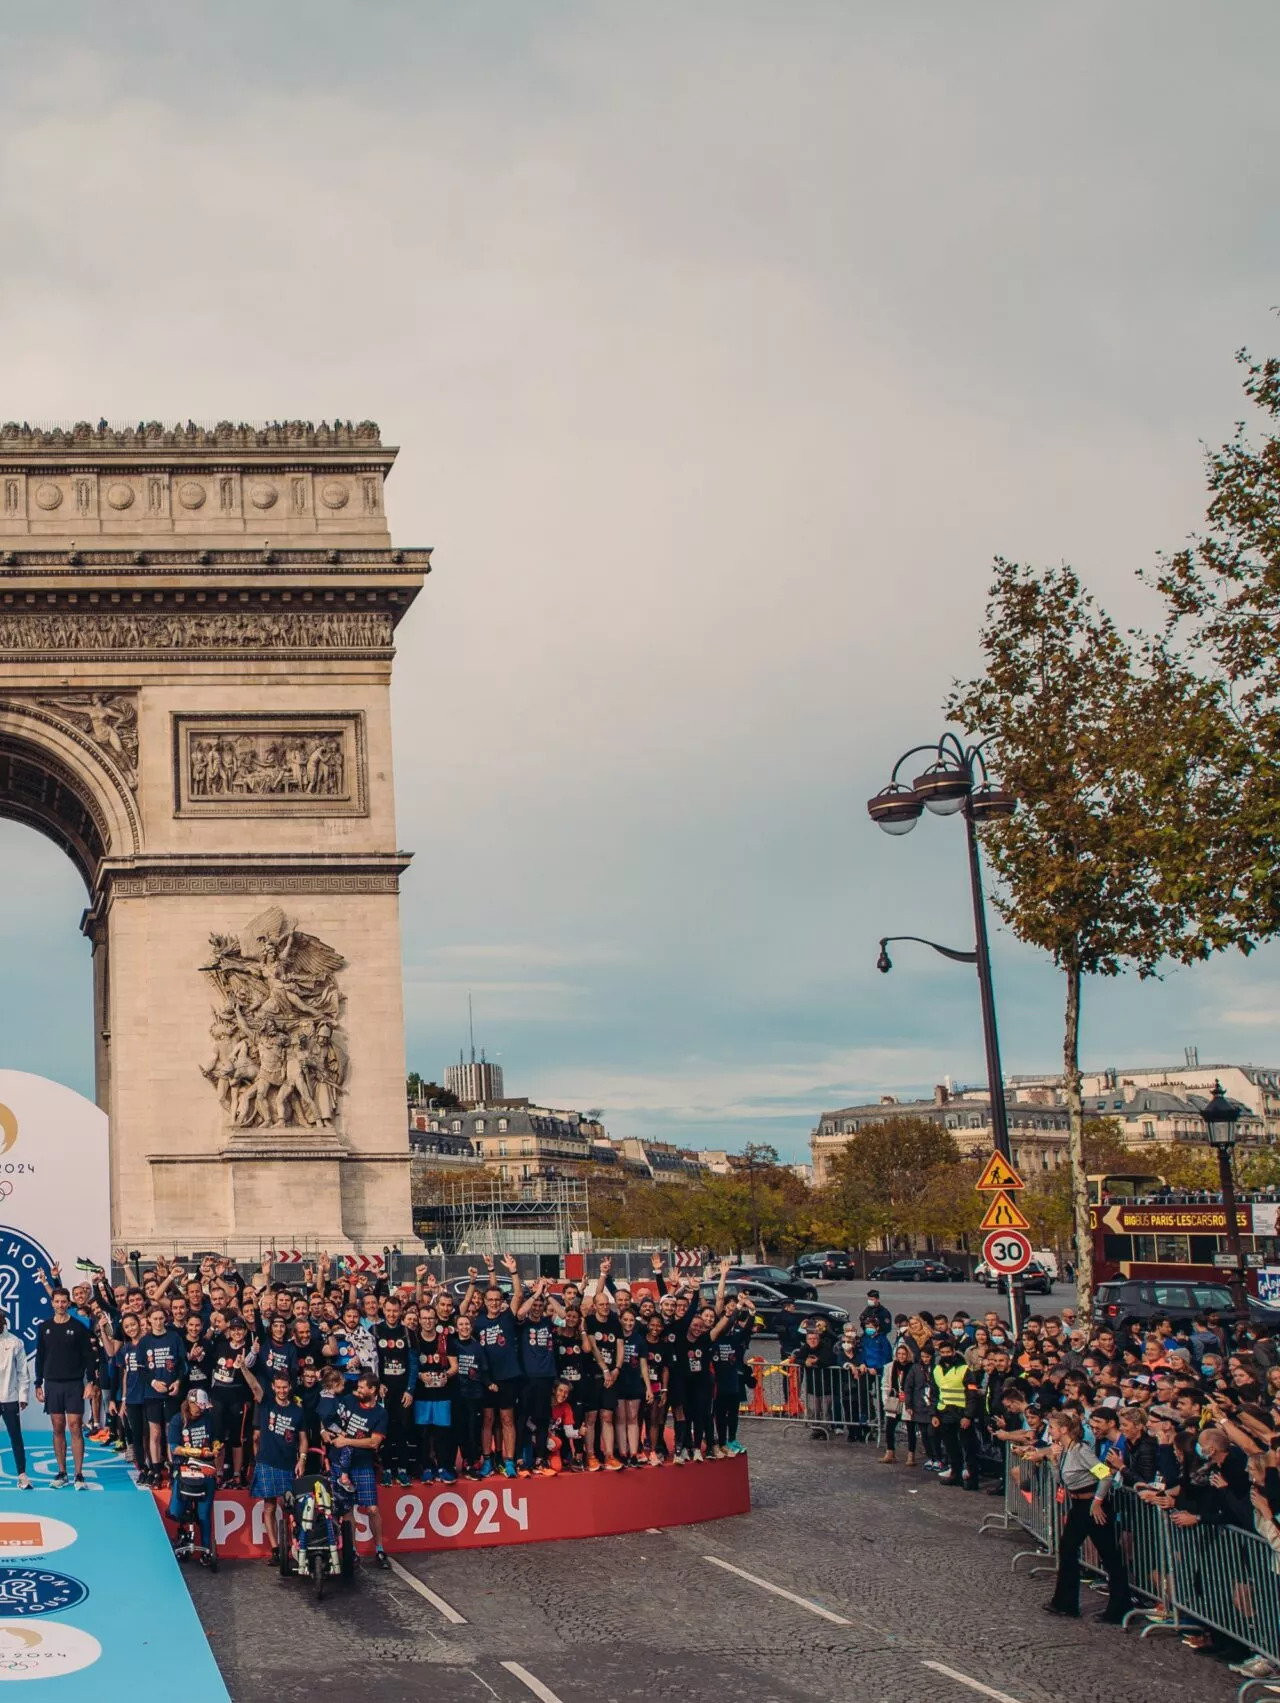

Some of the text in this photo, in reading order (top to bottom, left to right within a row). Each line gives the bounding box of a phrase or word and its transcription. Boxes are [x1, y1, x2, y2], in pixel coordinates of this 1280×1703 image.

[993, 1242, 1023, 1261] 30
[214, 1488, 529, 1545] PAS 2024
[14, 1596, 69, 1614] TOUS
